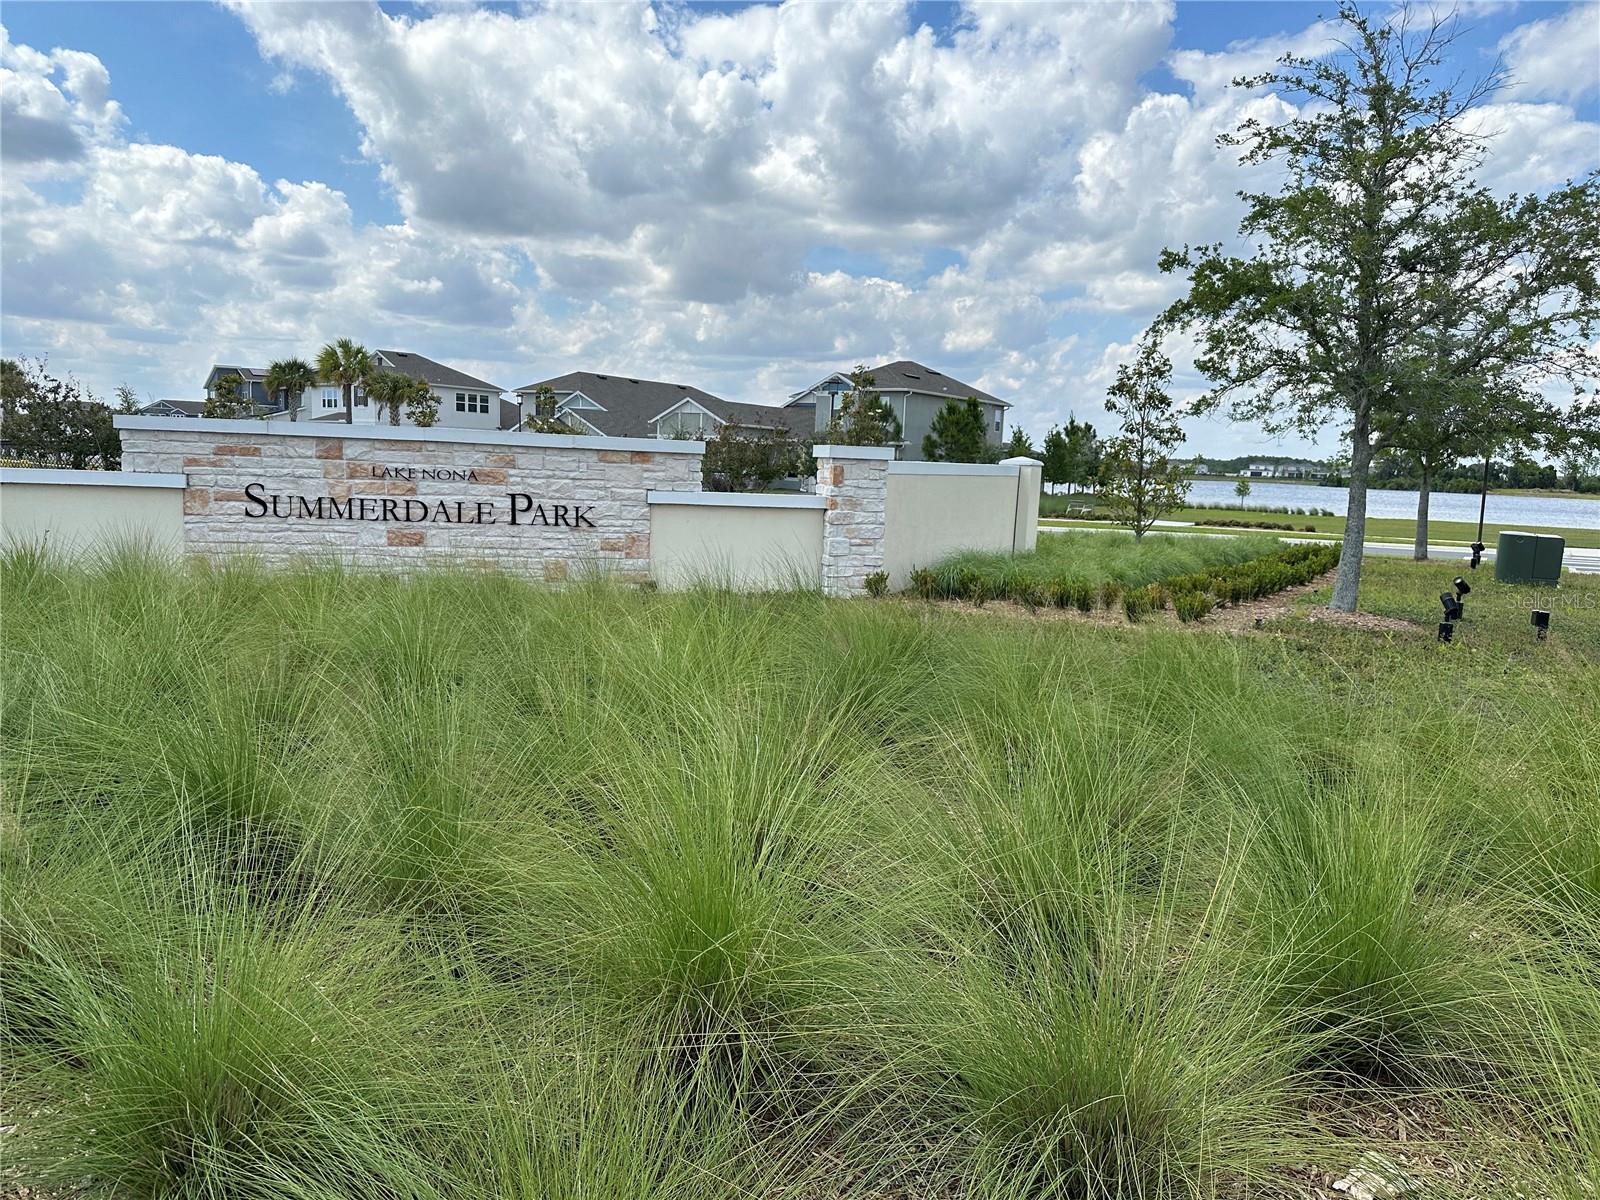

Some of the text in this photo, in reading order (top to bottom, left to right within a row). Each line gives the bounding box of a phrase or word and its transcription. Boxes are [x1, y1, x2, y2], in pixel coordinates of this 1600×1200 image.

[371, 465, 479, 482] LAKE NONA
[244, 482, 597, 528] SUMMERDALE PARK
